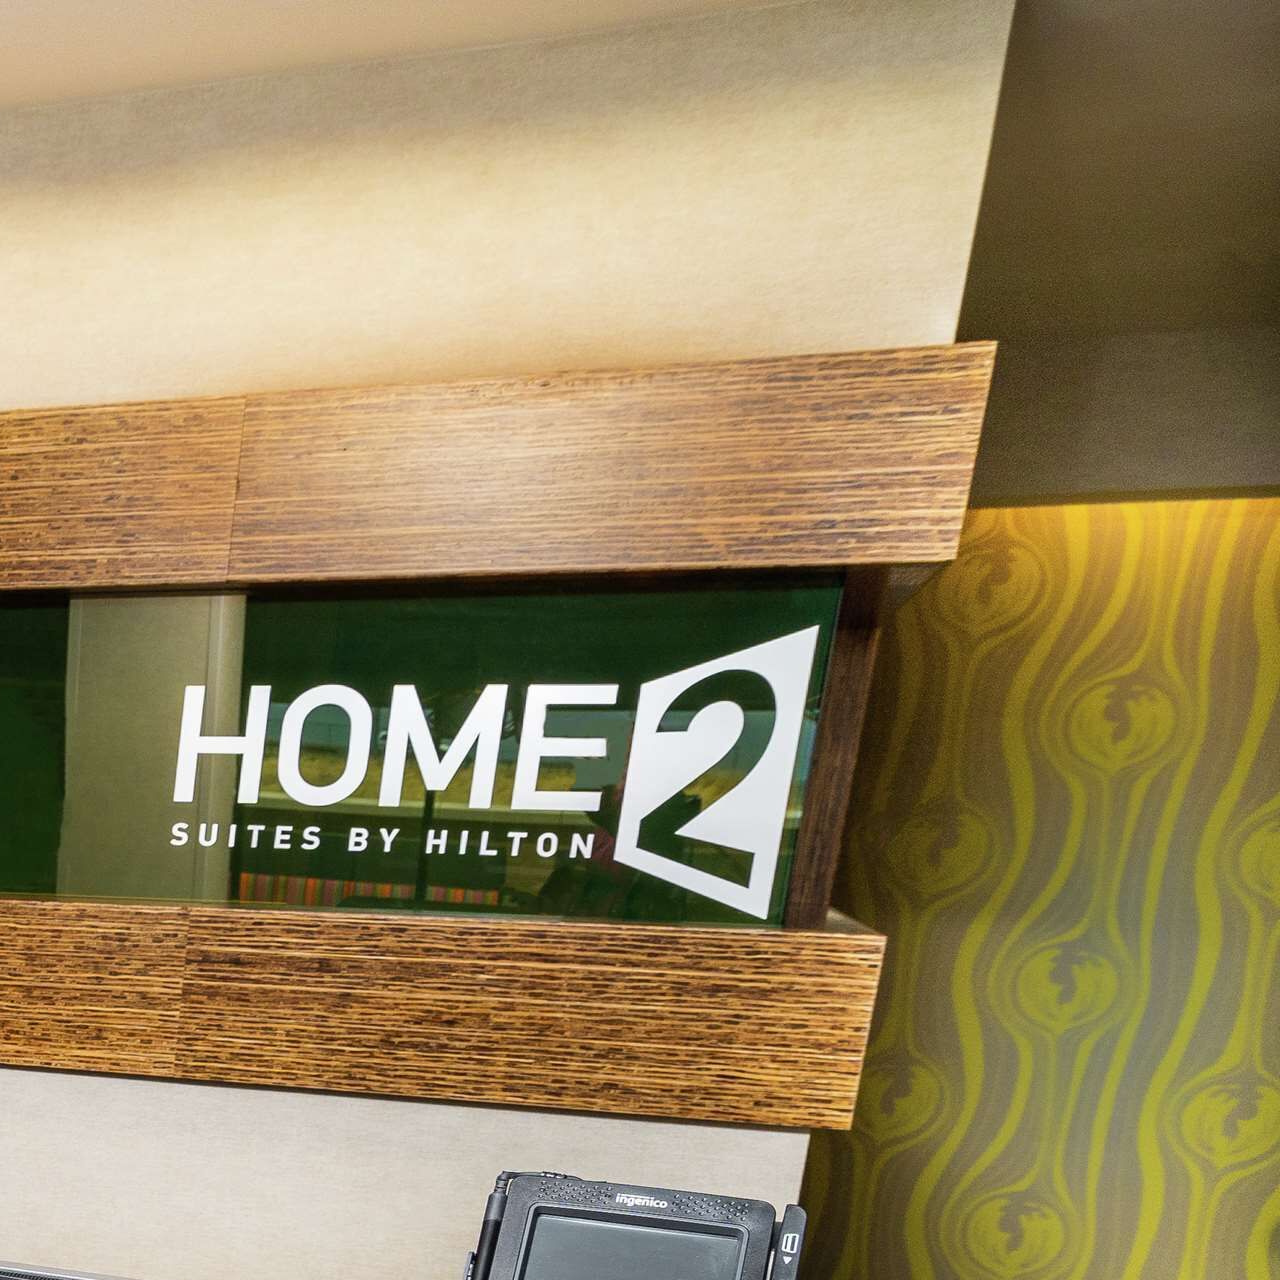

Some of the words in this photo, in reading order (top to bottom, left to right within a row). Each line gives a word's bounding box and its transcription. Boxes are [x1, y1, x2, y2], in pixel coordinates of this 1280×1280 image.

[172, 684, 619, 811] HOME
[170, 821, 321, 851] SUITES
[348, 827, 400, 853] BY
[425, 829, 595, 860] HILTON
[615, 1193, 668, 1209] ingenico
